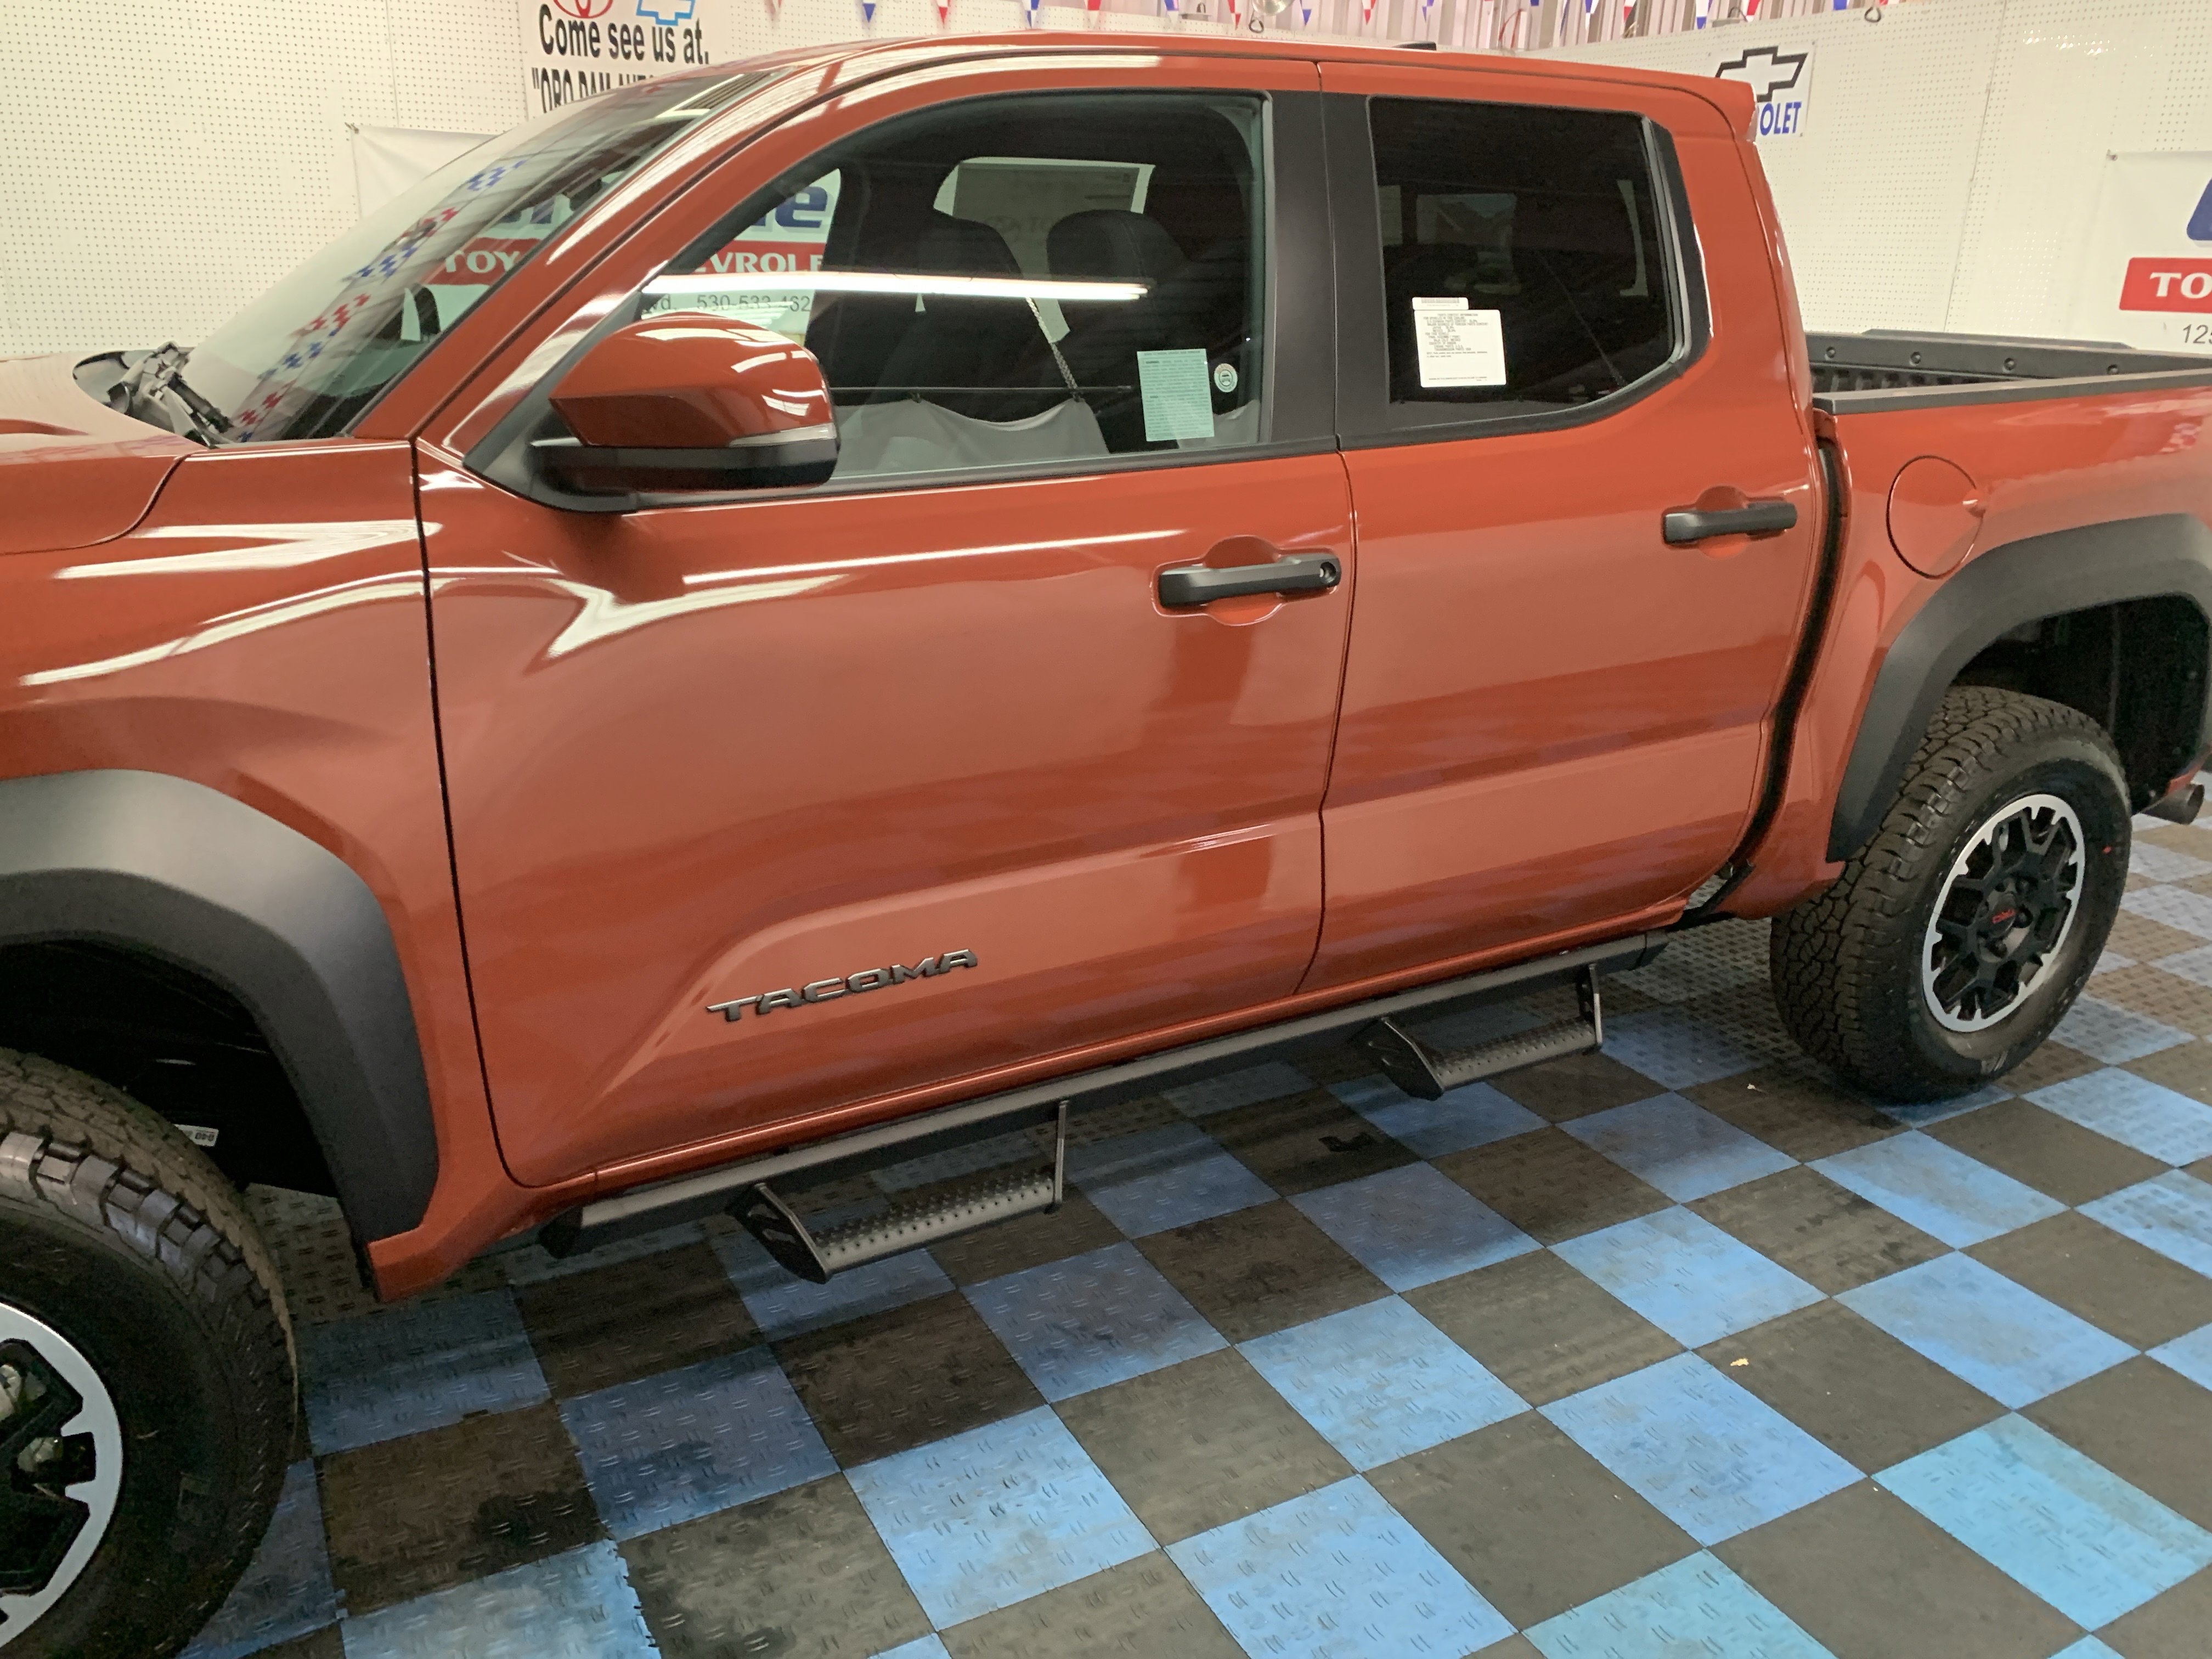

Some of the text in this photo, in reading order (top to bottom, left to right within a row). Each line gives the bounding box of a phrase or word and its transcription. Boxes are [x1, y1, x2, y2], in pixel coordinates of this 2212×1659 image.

[538, 4, 601, 58] Come
[608, 22, 645, 61] see
[652, 26, 676, 63] us
[2183, 324, 2212, 345] 12
[706, 949, 978, 1022] TACOMA
